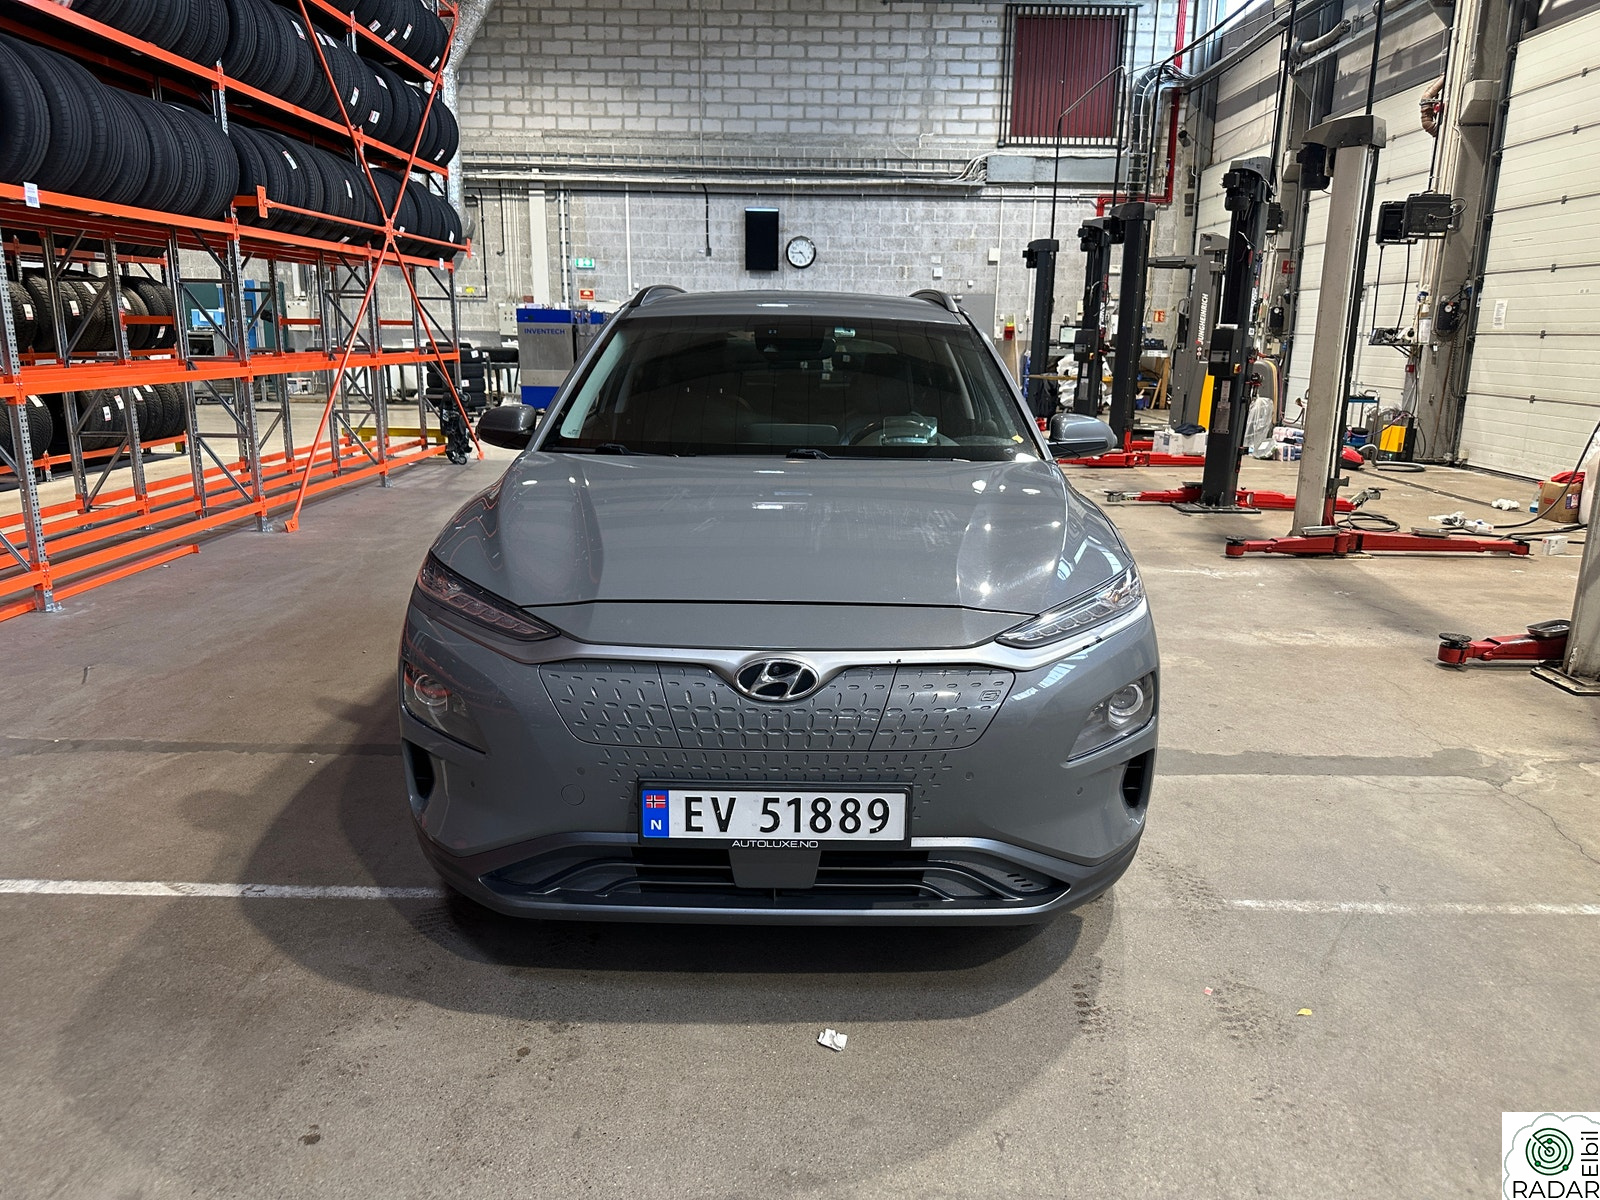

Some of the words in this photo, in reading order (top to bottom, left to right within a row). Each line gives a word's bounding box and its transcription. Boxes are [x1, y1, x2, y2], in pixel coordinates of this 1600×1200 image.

[1197, 293, 1209, 345] JUNGHEINRICH
[650, 819, 662, 831] N
[684, 796, 737, 833] EV
[759, 797, 890, 834] 51889
[731, 839, 819, 849] AUTOLUXE.NO
